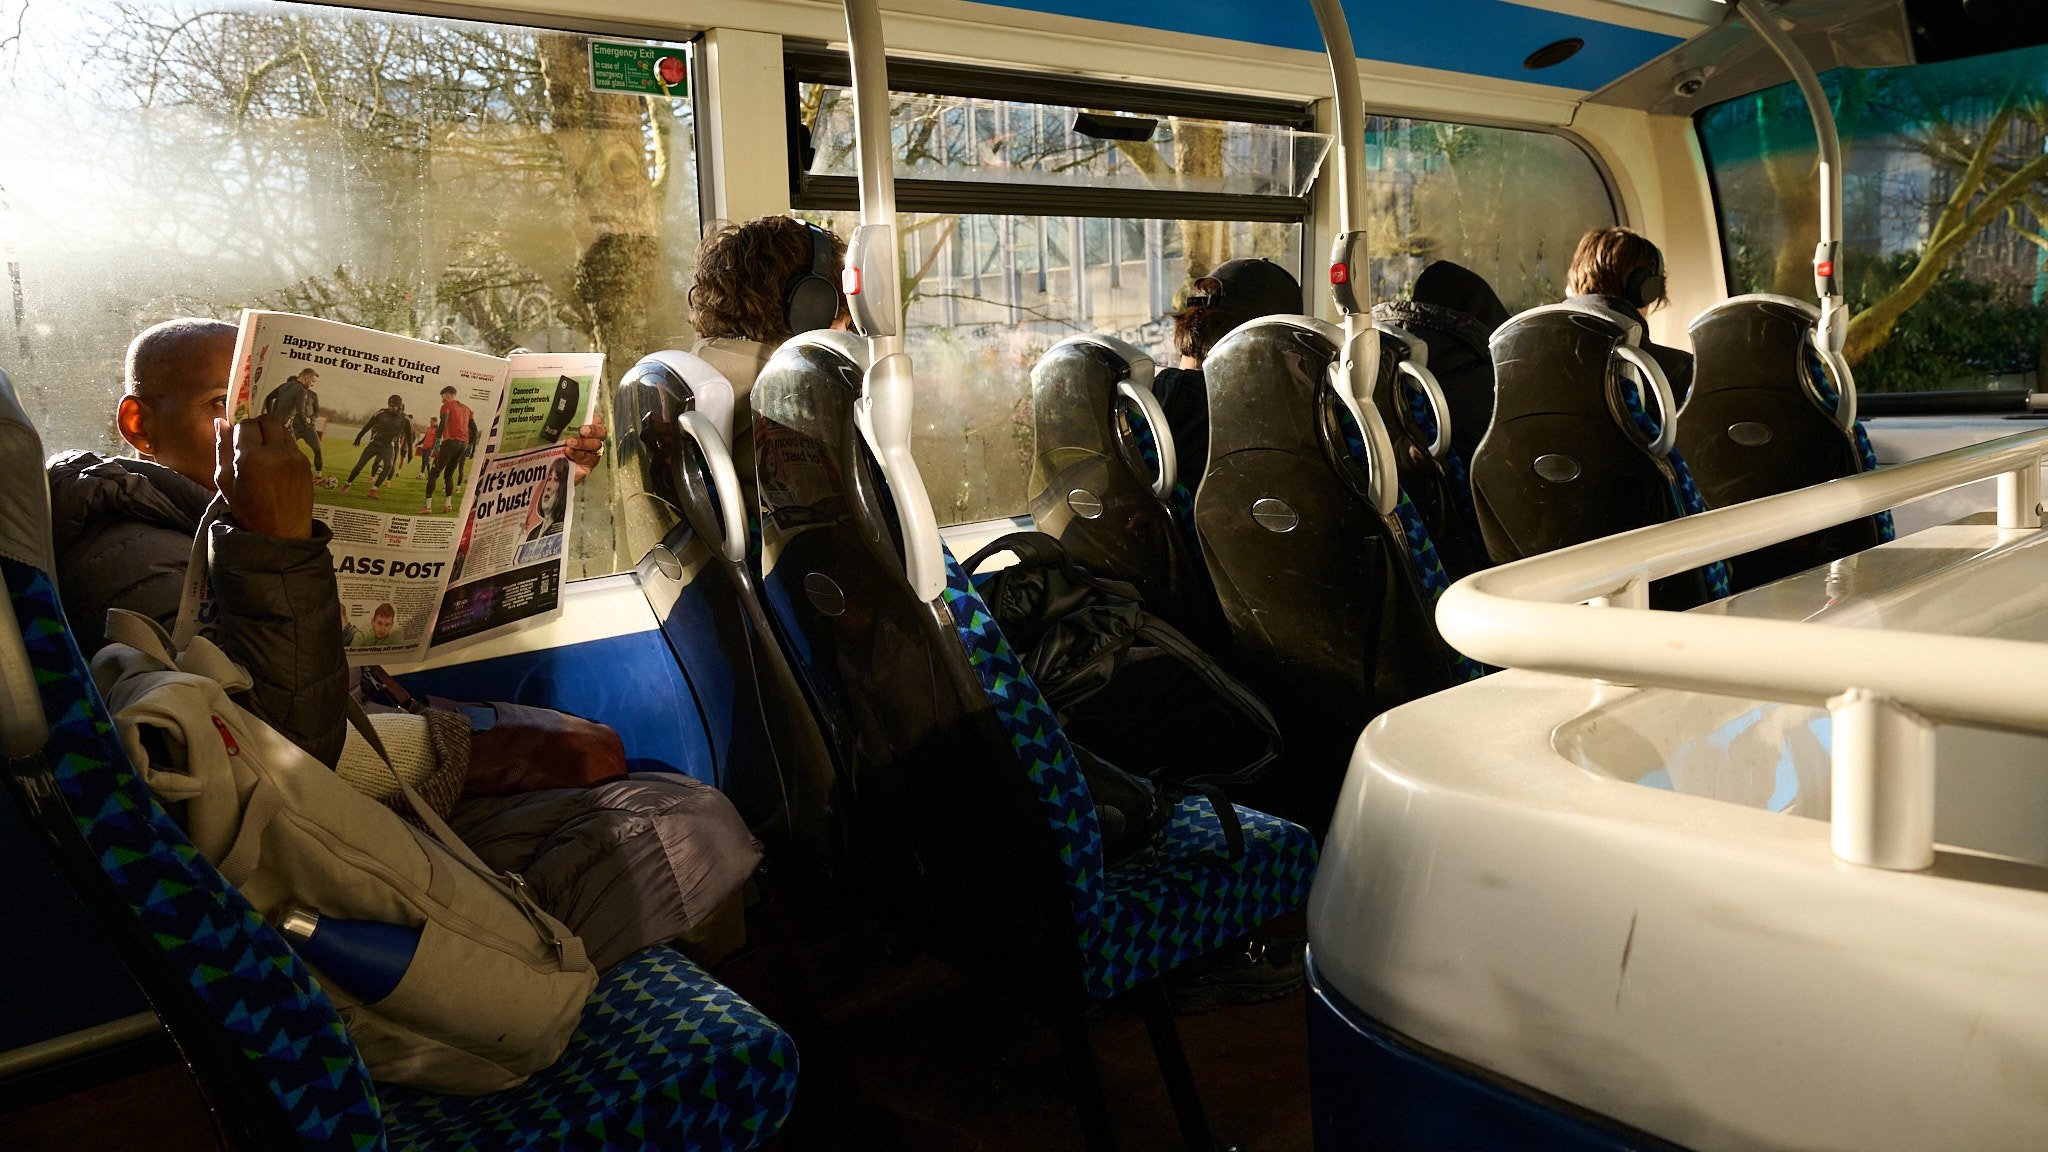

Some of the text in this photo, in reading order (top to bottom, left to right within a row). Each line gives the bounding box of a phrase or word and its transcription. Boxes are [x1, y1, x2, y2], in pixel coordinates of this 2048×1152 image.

[594, 44, 655, 59] Emergency Exit
[596, 71, 624, 80] emergency
[612, 80, 625, 88] glass
[282, 334, 440, 374] Happy returns at United
[289, 349, 311, 362] but
[314, 356, 338, 366] not
[340, 358, 362, 372] for
[363, 363, 424, 384] Rashford
[512, 387, 534, 395] Connect
[508, 417, 518, 425] you
[529, 414, 544, 423] signal
[483, 464, 547, 494] It's boom
[477, 486, 533, 519] or bust!
[389, 560, 445, 578] POST
